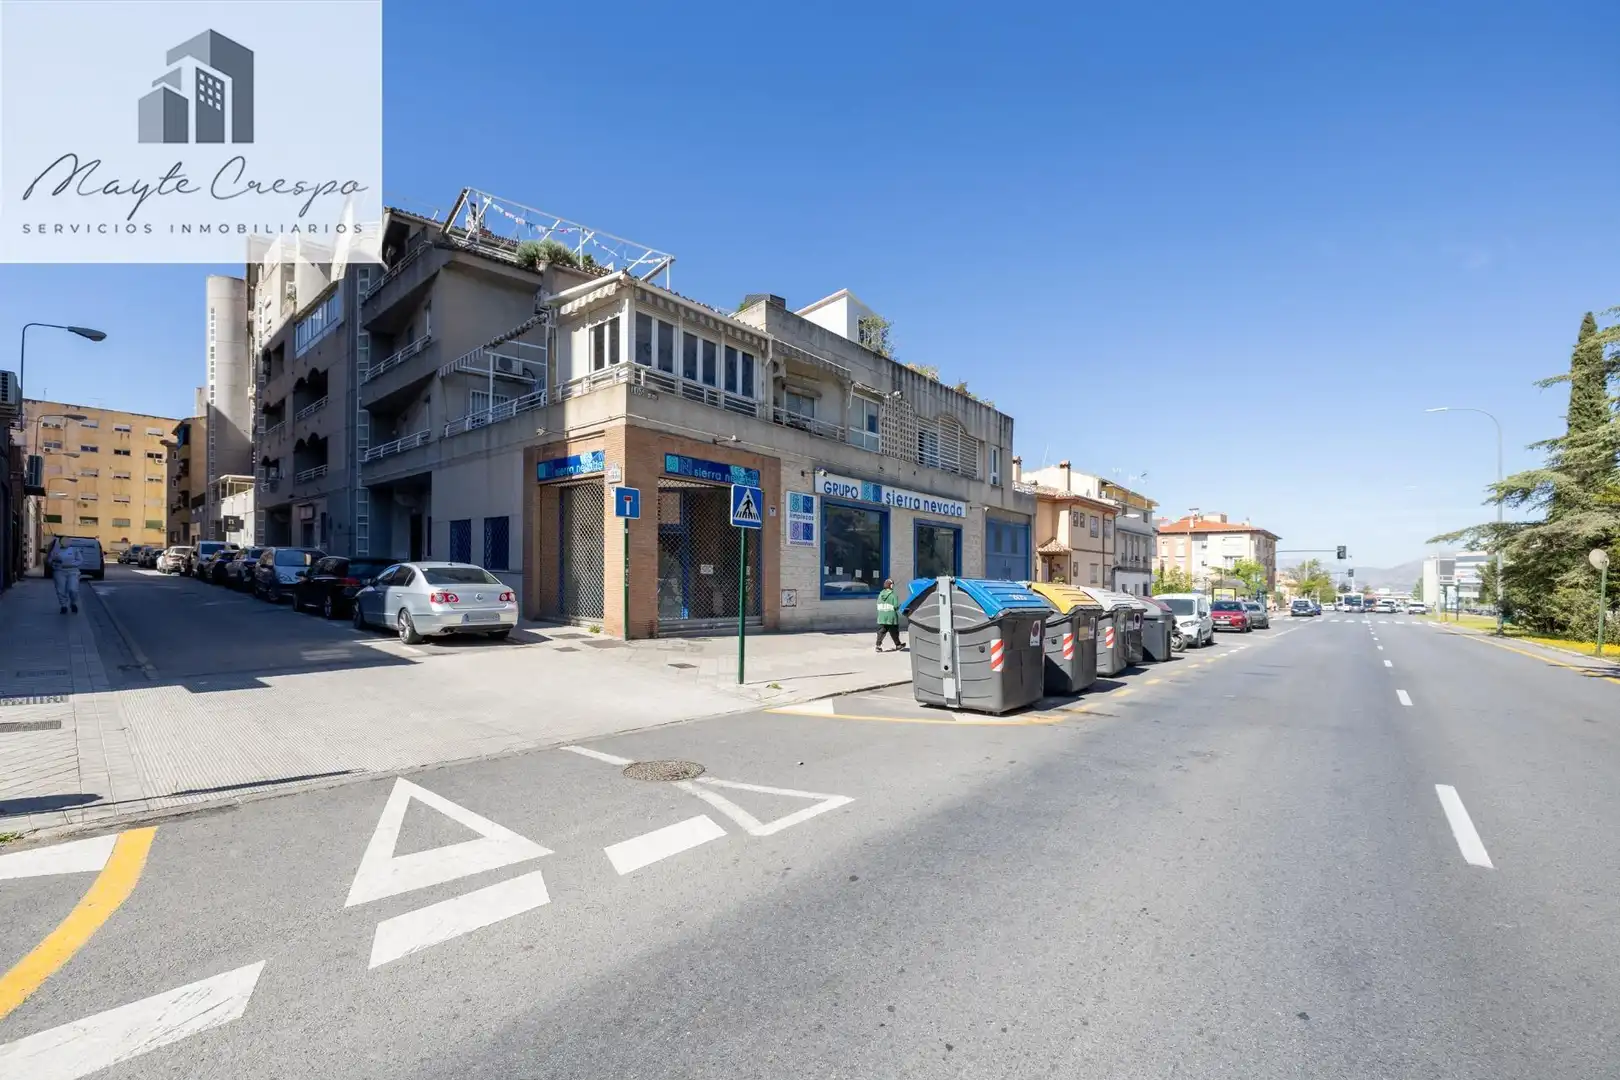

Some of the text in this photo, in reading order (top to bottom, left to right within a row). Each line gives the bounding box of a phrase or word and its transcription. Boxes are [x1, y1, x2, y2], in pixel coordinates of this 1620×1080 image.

[694, 467, 722, 481] sierra
[823, 480, 859, 499] GRUPO
[886, 489, 921, 510] sierra
[923, 499, 963, 517] nevada
